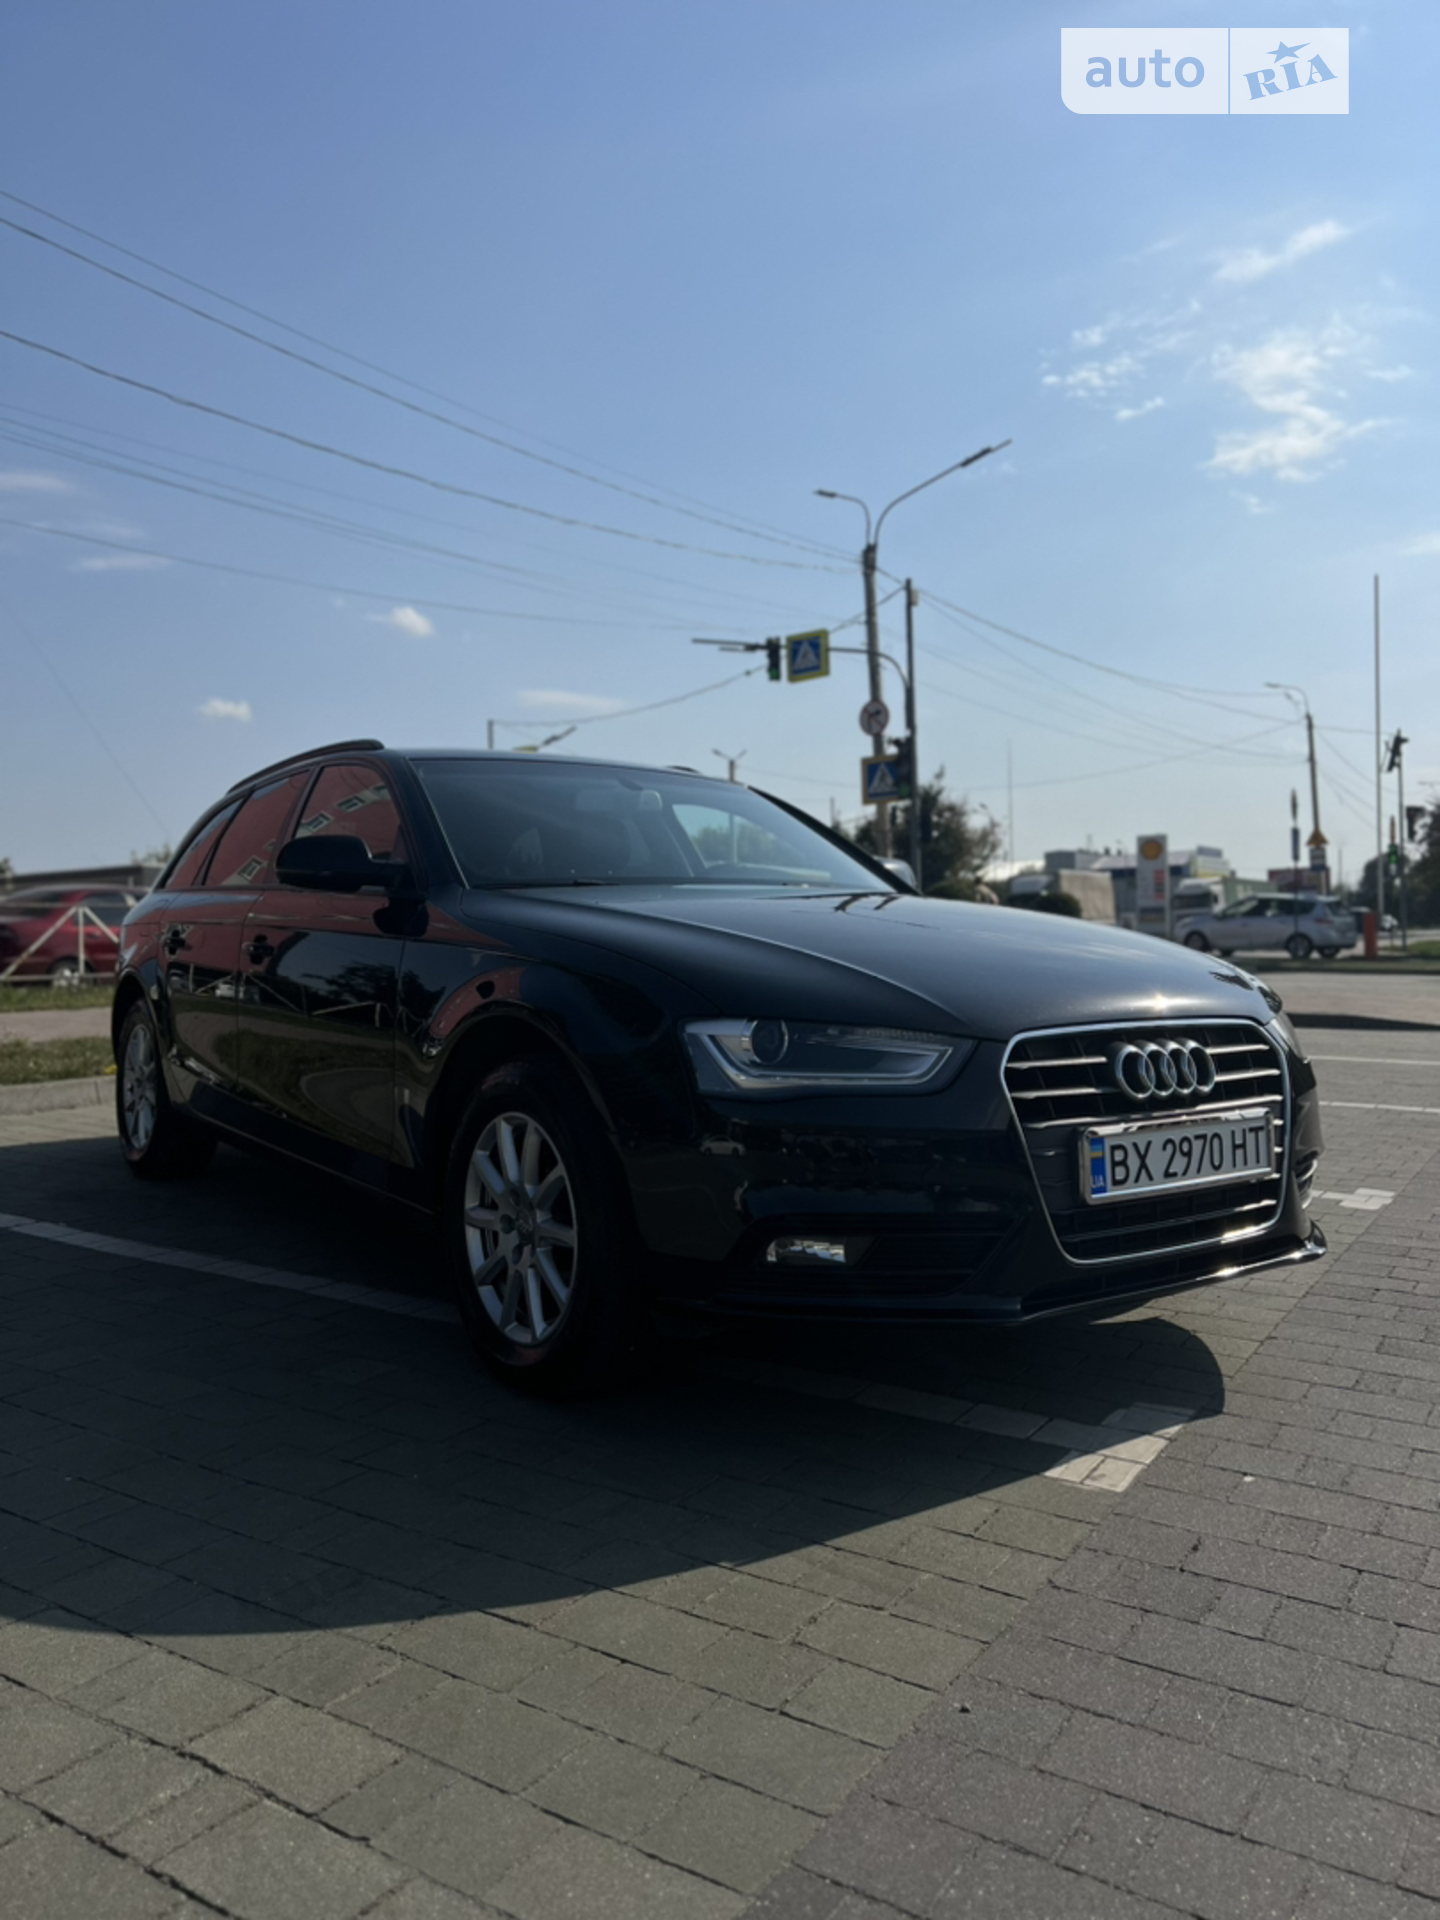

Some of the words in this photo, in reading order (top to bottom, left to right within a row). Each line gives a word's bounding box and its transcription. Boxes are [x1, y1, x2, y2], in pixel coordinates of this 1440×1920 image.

[1109, 1140, 1154, 1186] BX
[1162, 1132, 1224, 1178] 2970
[1231, 1126, 1265, 1168] HT
[1091, 1174, 1105, 1188] UA
